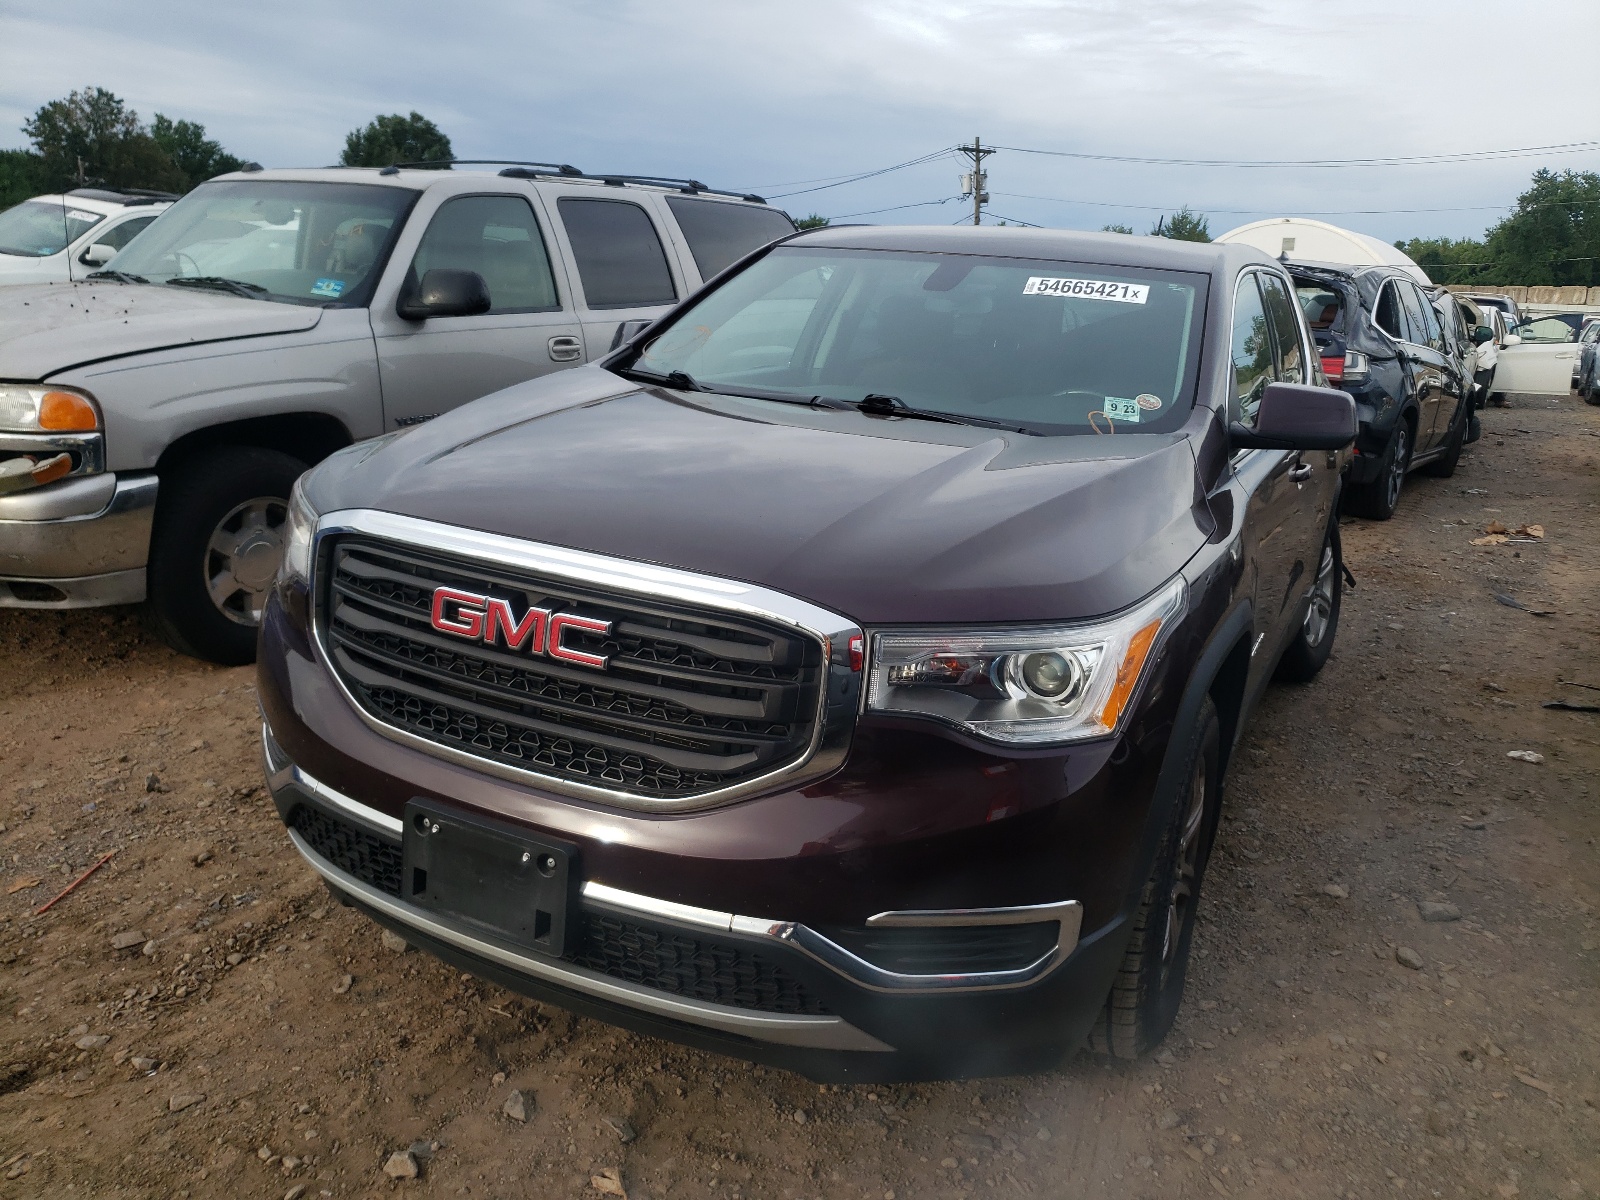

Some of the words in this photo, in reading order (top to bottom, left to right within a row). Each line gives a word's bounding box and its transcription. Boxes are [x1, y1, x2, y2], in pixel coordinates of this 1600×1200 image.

[1110, 402, 1118, 412] 9
[1123, 404, 1136, 414] 23
[430, 586, 613, 670] GMC
